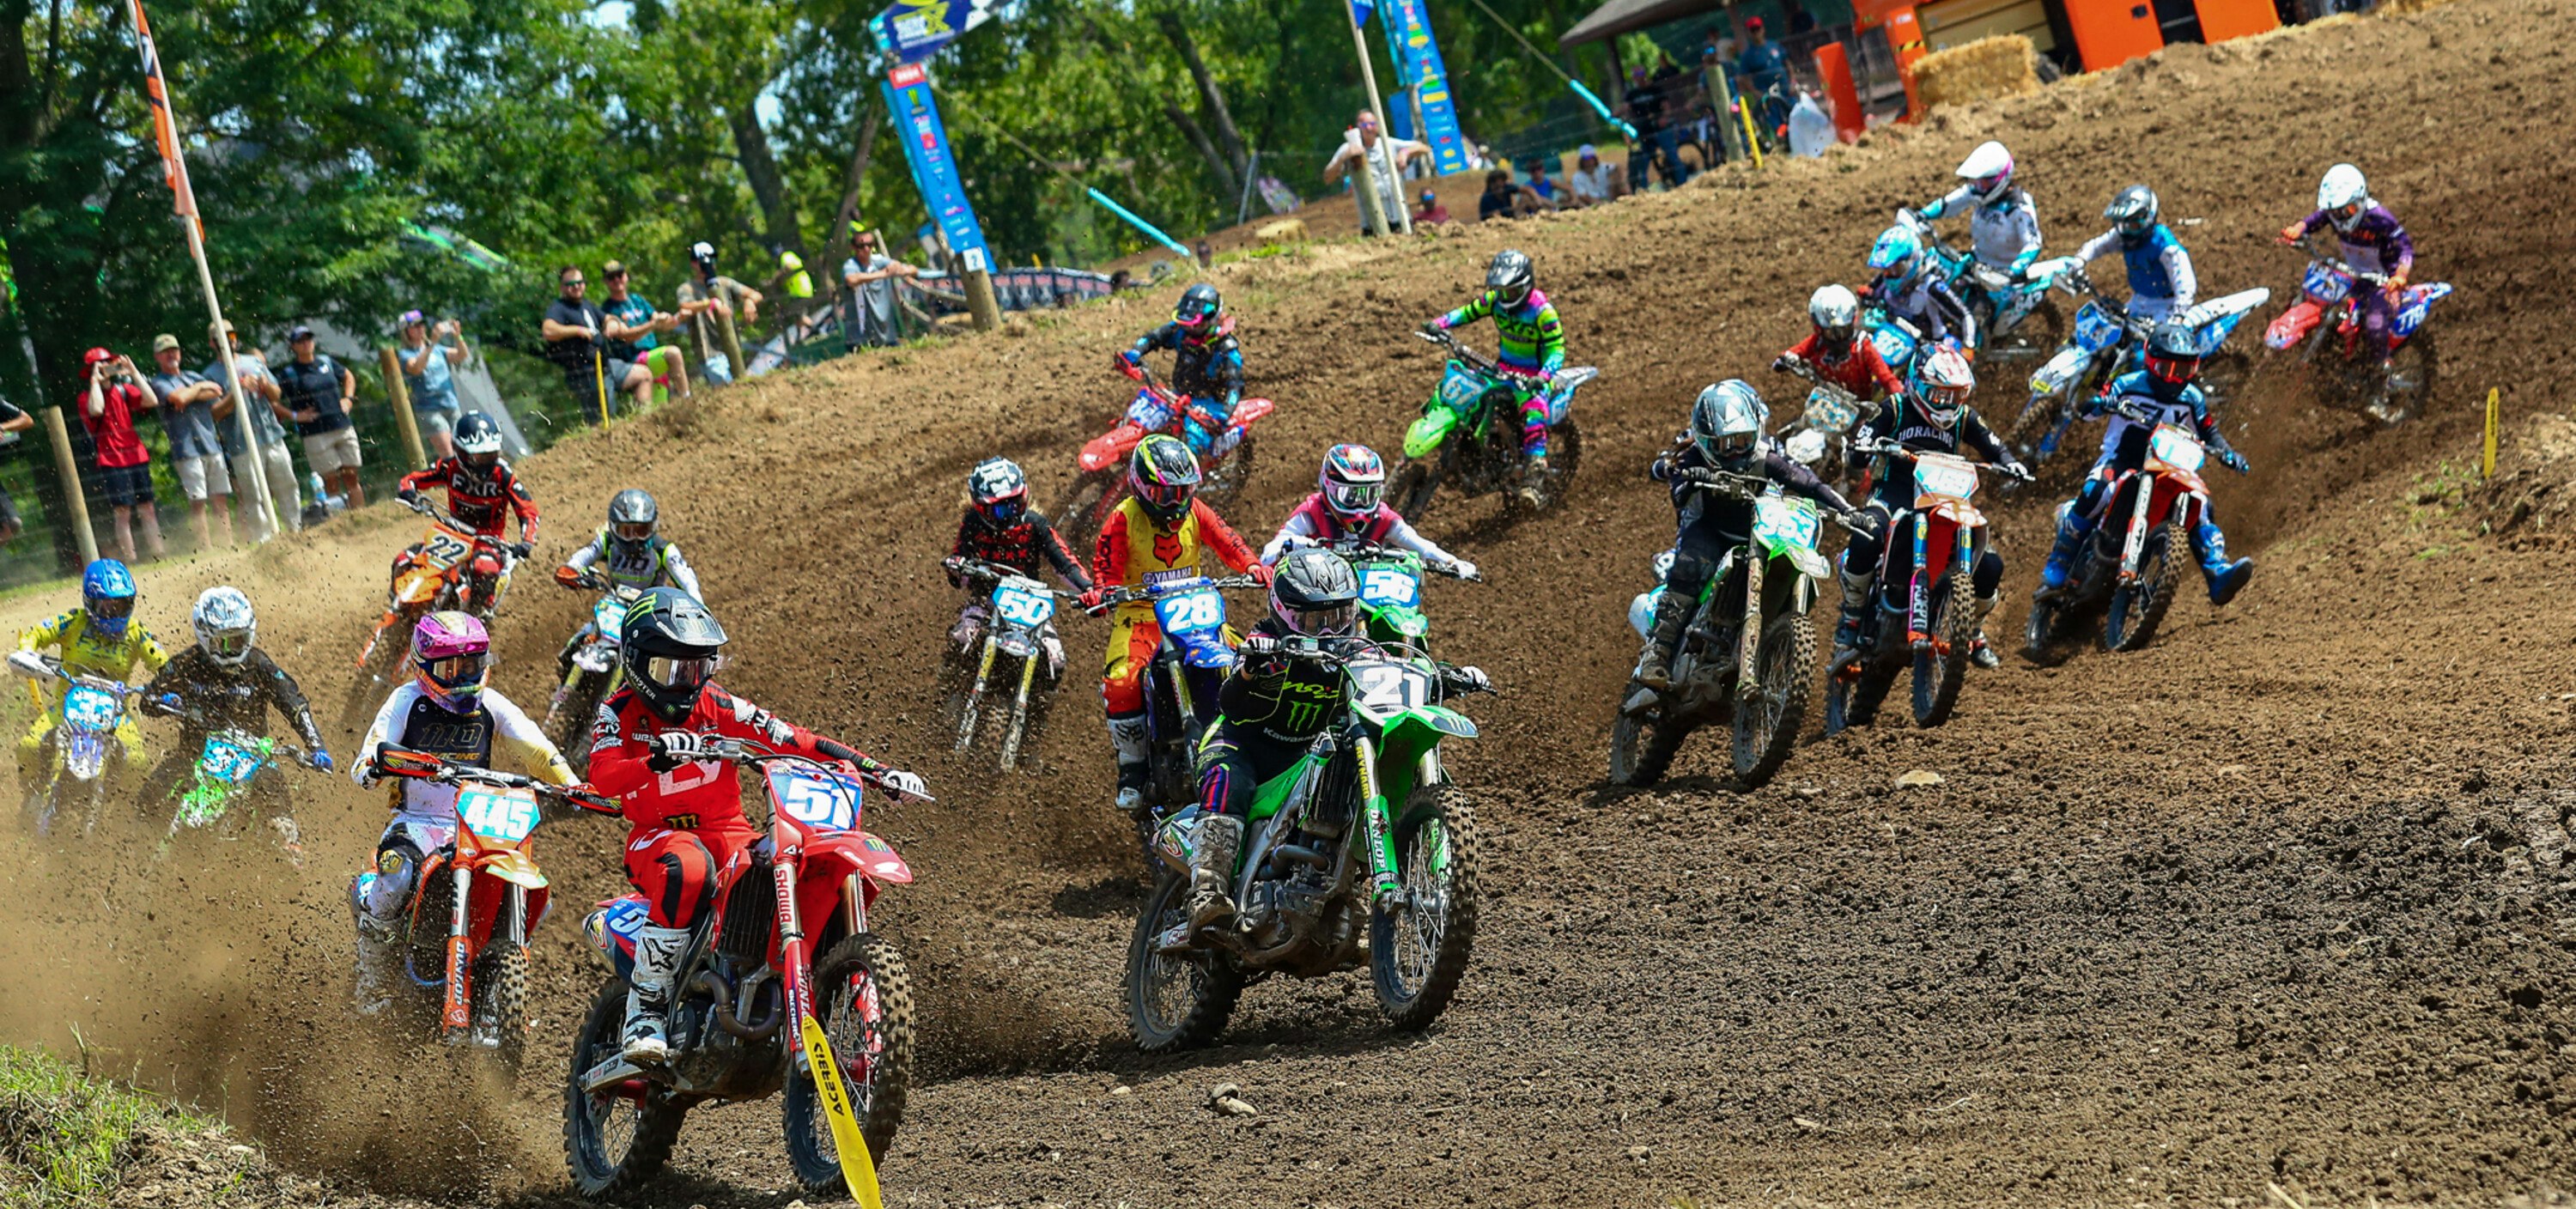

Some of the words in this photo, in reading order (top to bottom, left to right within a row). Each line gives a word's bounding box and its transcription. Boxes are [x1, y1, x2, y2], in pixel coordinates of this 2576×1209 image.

[452, 473, 498, 496] FXR
[1759, 502, 1816, 550] 953
[428, 535, 468, 564] 22
[1154, 567, 1193, 583] YAMAHA
[1363, 570, 1416, 603] 56
[997, 587, 1054, 627] 50
[1164, 594, 1219, 633] 28
[1361, 666, 1425, 710] 21
[1356, 745, 1370, 799] REYNARD
[464, 794, 533, 838] 445
[784, 777, 857, 830] 51
[1369, 808, 1386, 869] DUNLOP
[773, 868, 793, 925] SHOWA
[455, 940, 467, 1005] DUNLOP
[813, 1042, 845, 1116] ACERBIS
